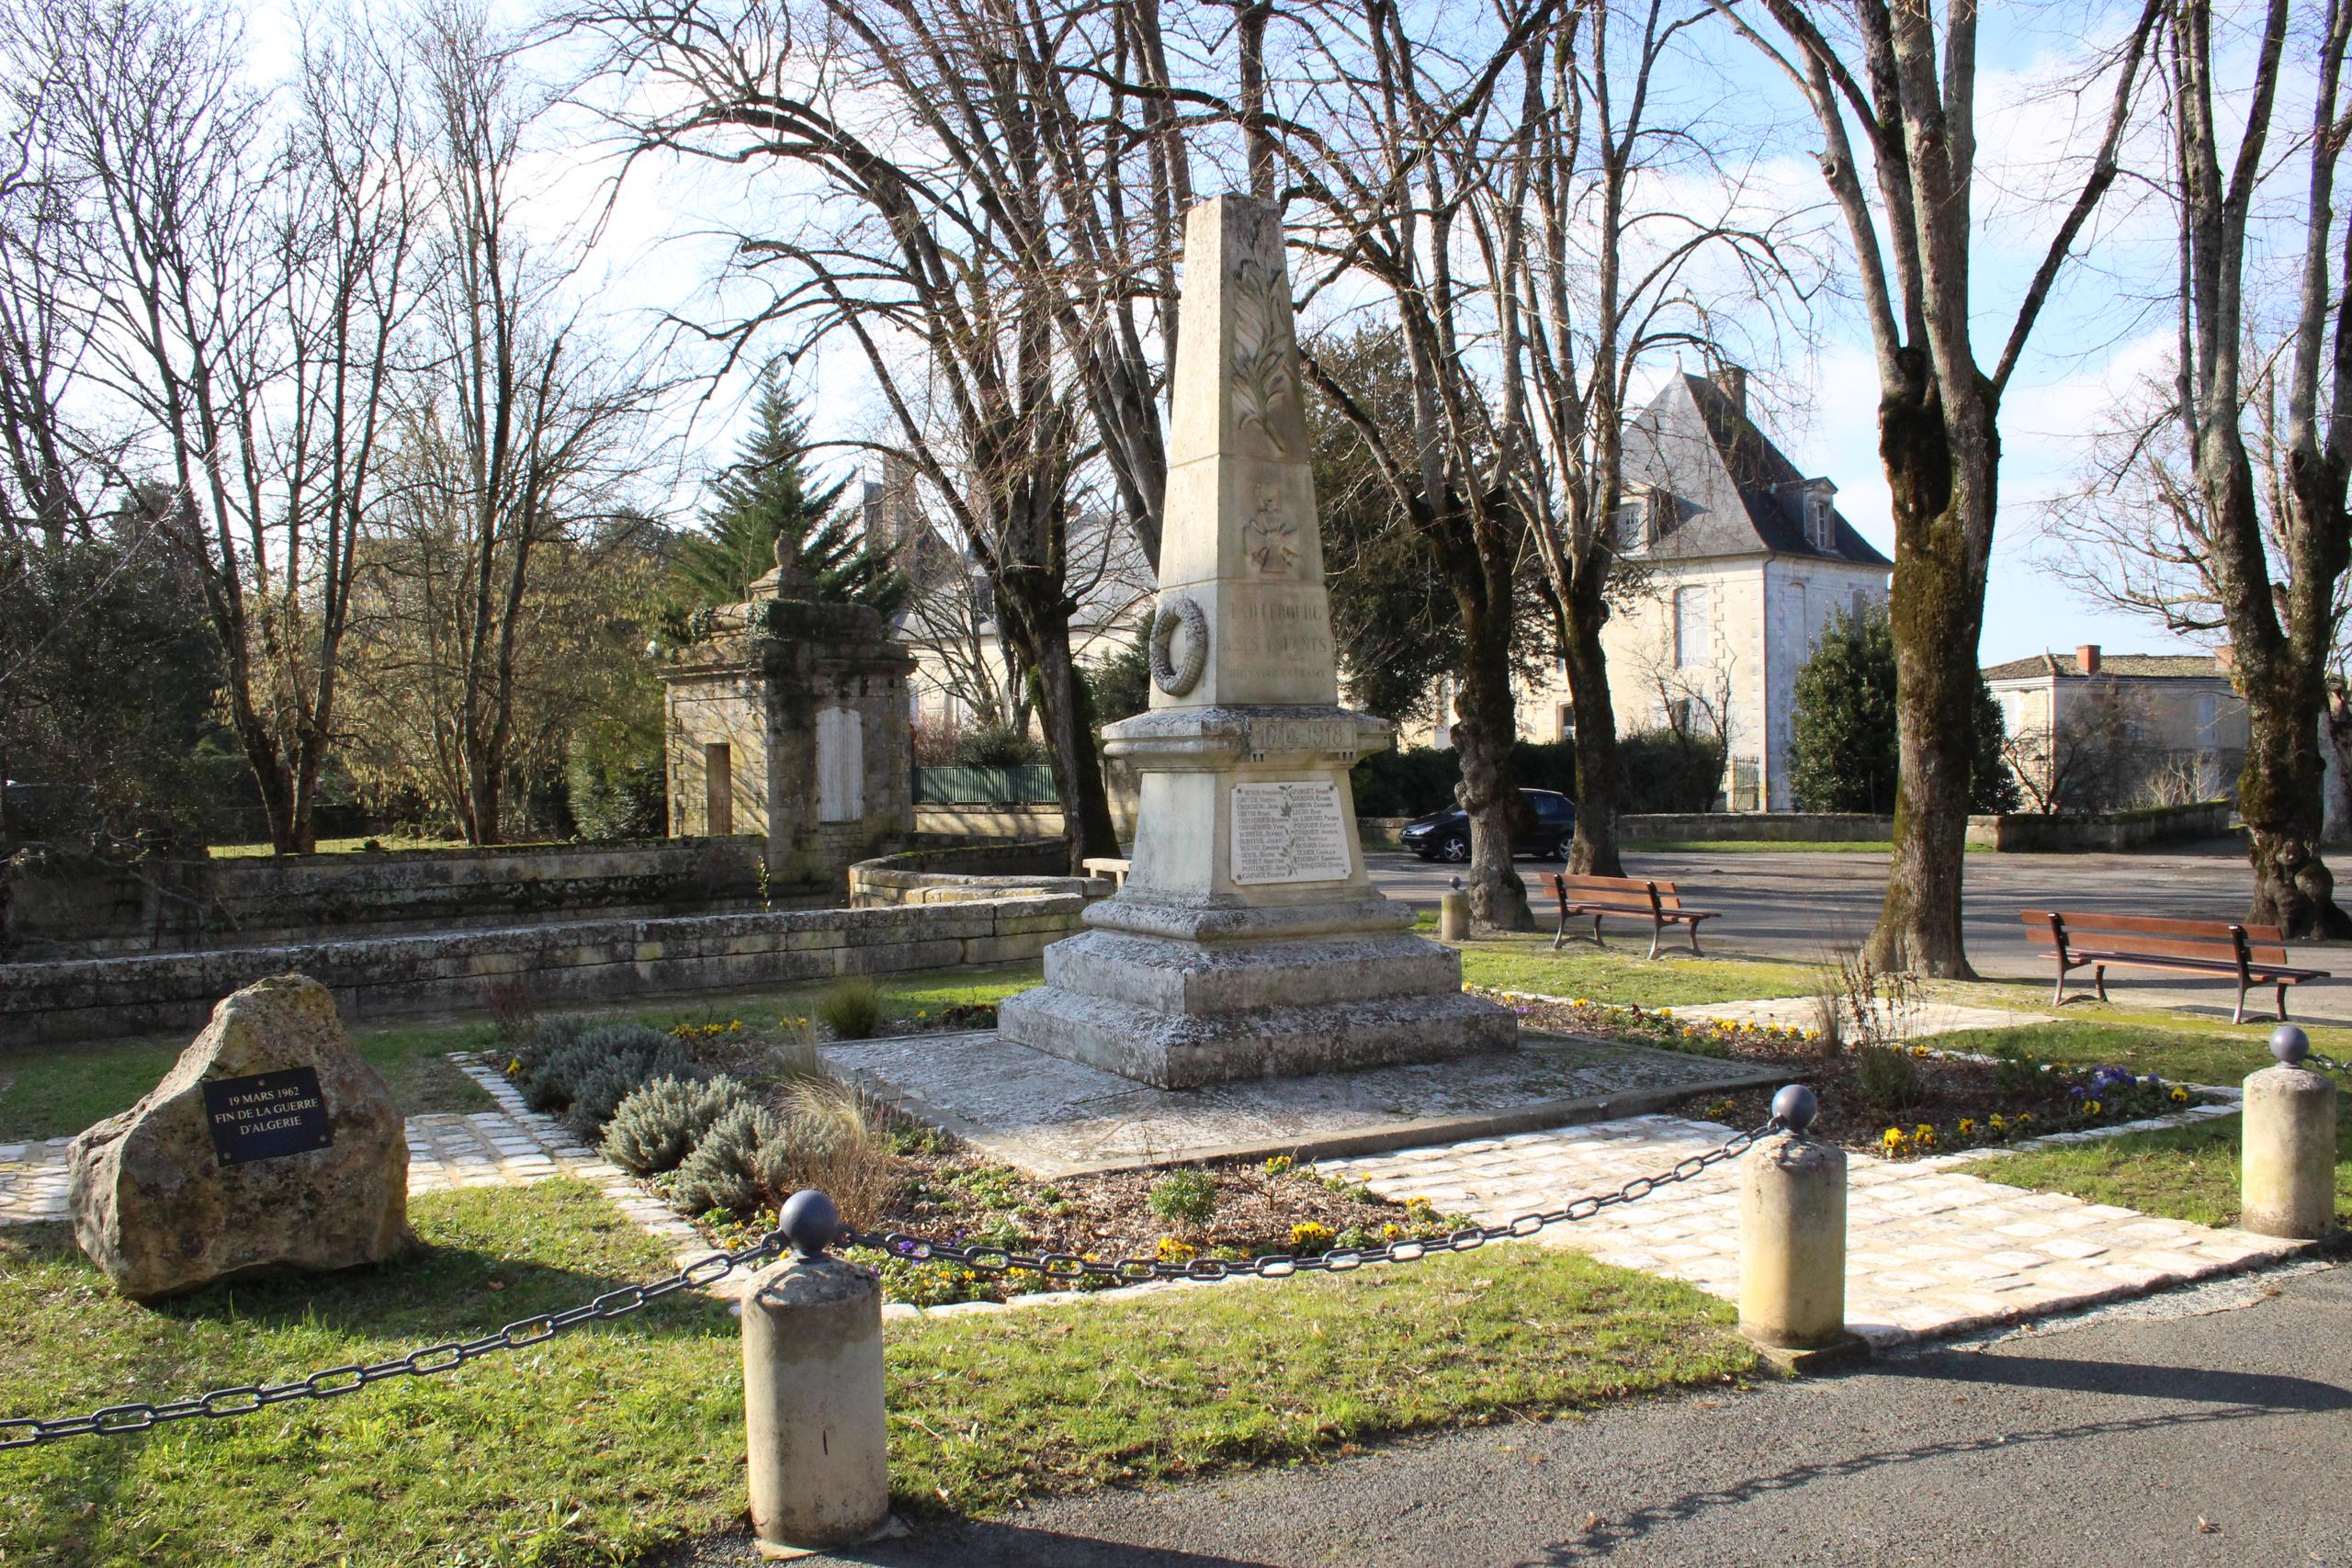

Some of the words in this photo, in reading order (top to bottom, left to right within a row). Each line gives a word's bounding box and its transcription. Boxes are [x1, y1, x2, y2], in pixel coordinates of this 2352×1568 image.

[229, 1096, 240, 1107] 19
[243, 1090, 275, 1104] MARS
[277, 1087, 300, 1098] 1962
[215, 1112, 235, 1123] FIN
[238, 1109, 254, 1120] DE
[255, 1105, 272, 1117] LA
[274, 1098, 320, 1114] GUERRE
[240, 1115, 302, 1135] D'ALGERIE
